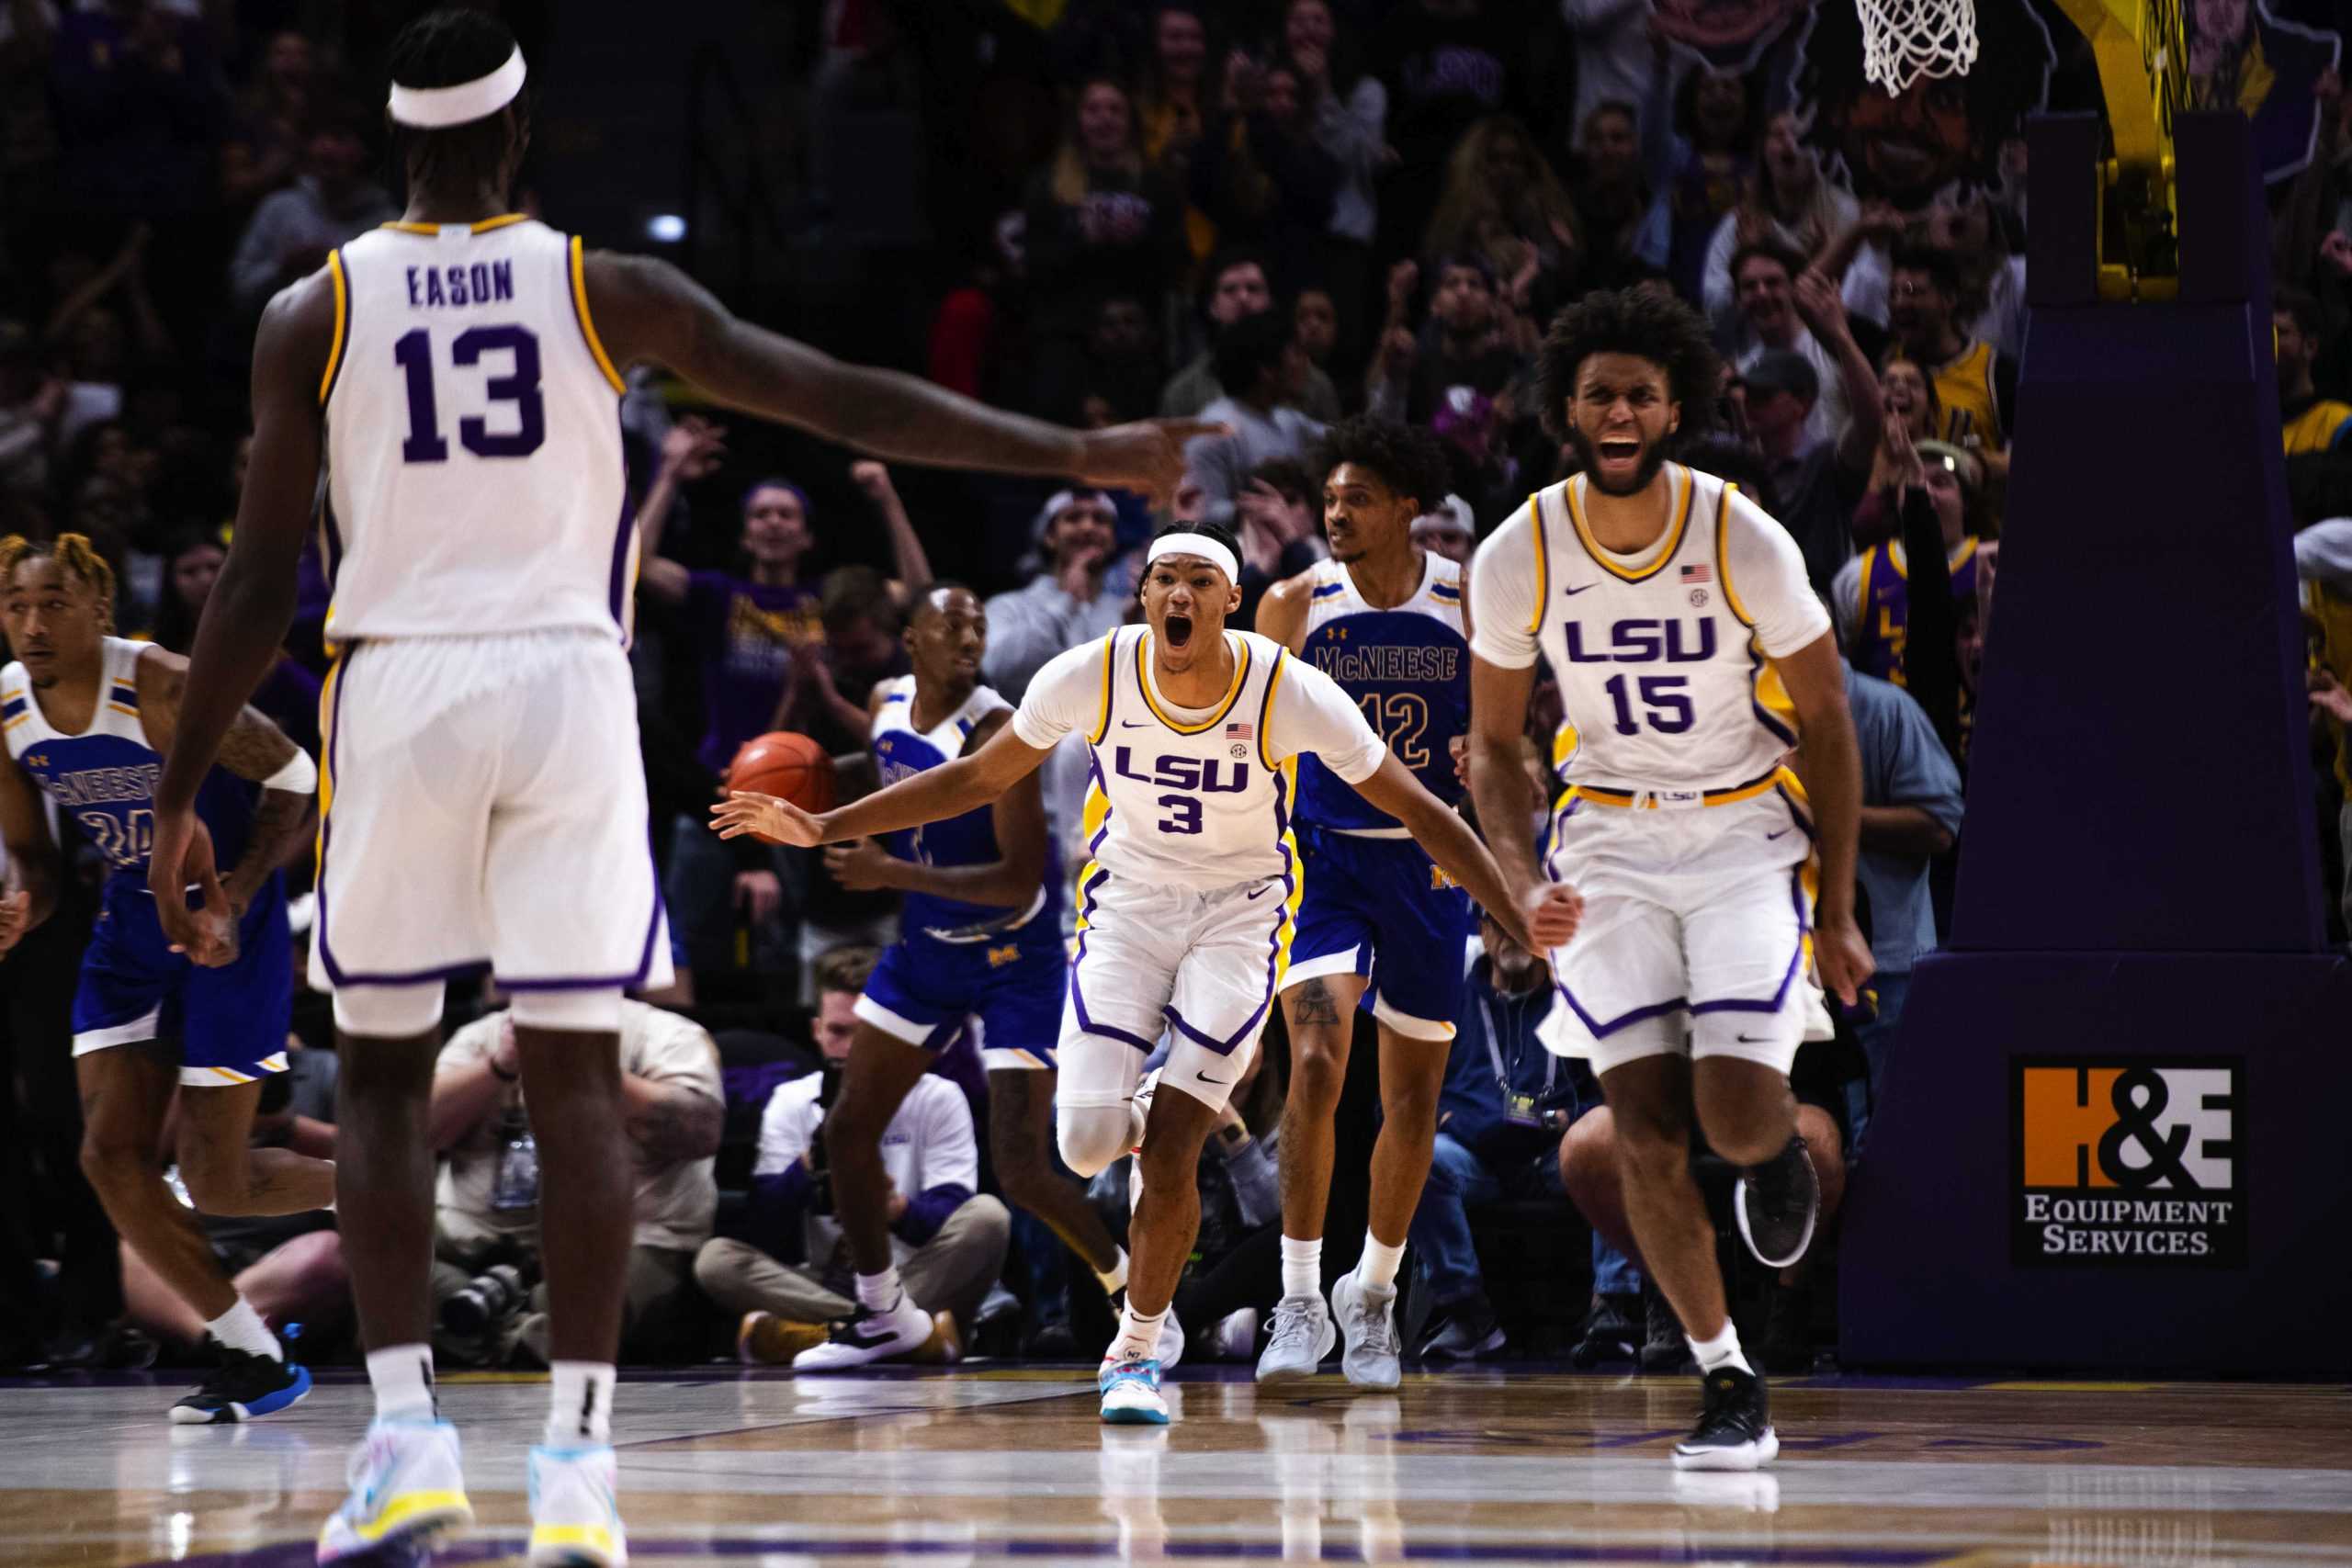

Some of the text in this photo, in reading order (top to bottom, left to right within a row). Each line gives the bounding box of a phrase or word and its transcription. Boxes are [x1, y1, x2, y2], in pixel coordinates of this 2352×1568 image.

[407, 258, 514, 307] EASON
[394, 323, 546, 463] 13
[1316, 646, 1459, 682] McNEESE
[1565, 616, 1718, 663] LSU
[1605, 673, 1695, 736] 15
[1115, 745, 1250, 794] LSU
[1158, 794, 1204, 835] 3
[2023, 1066, 2233, 1190] H&E
[2023, 1193, 2233, 1225] EQUIPMENT
